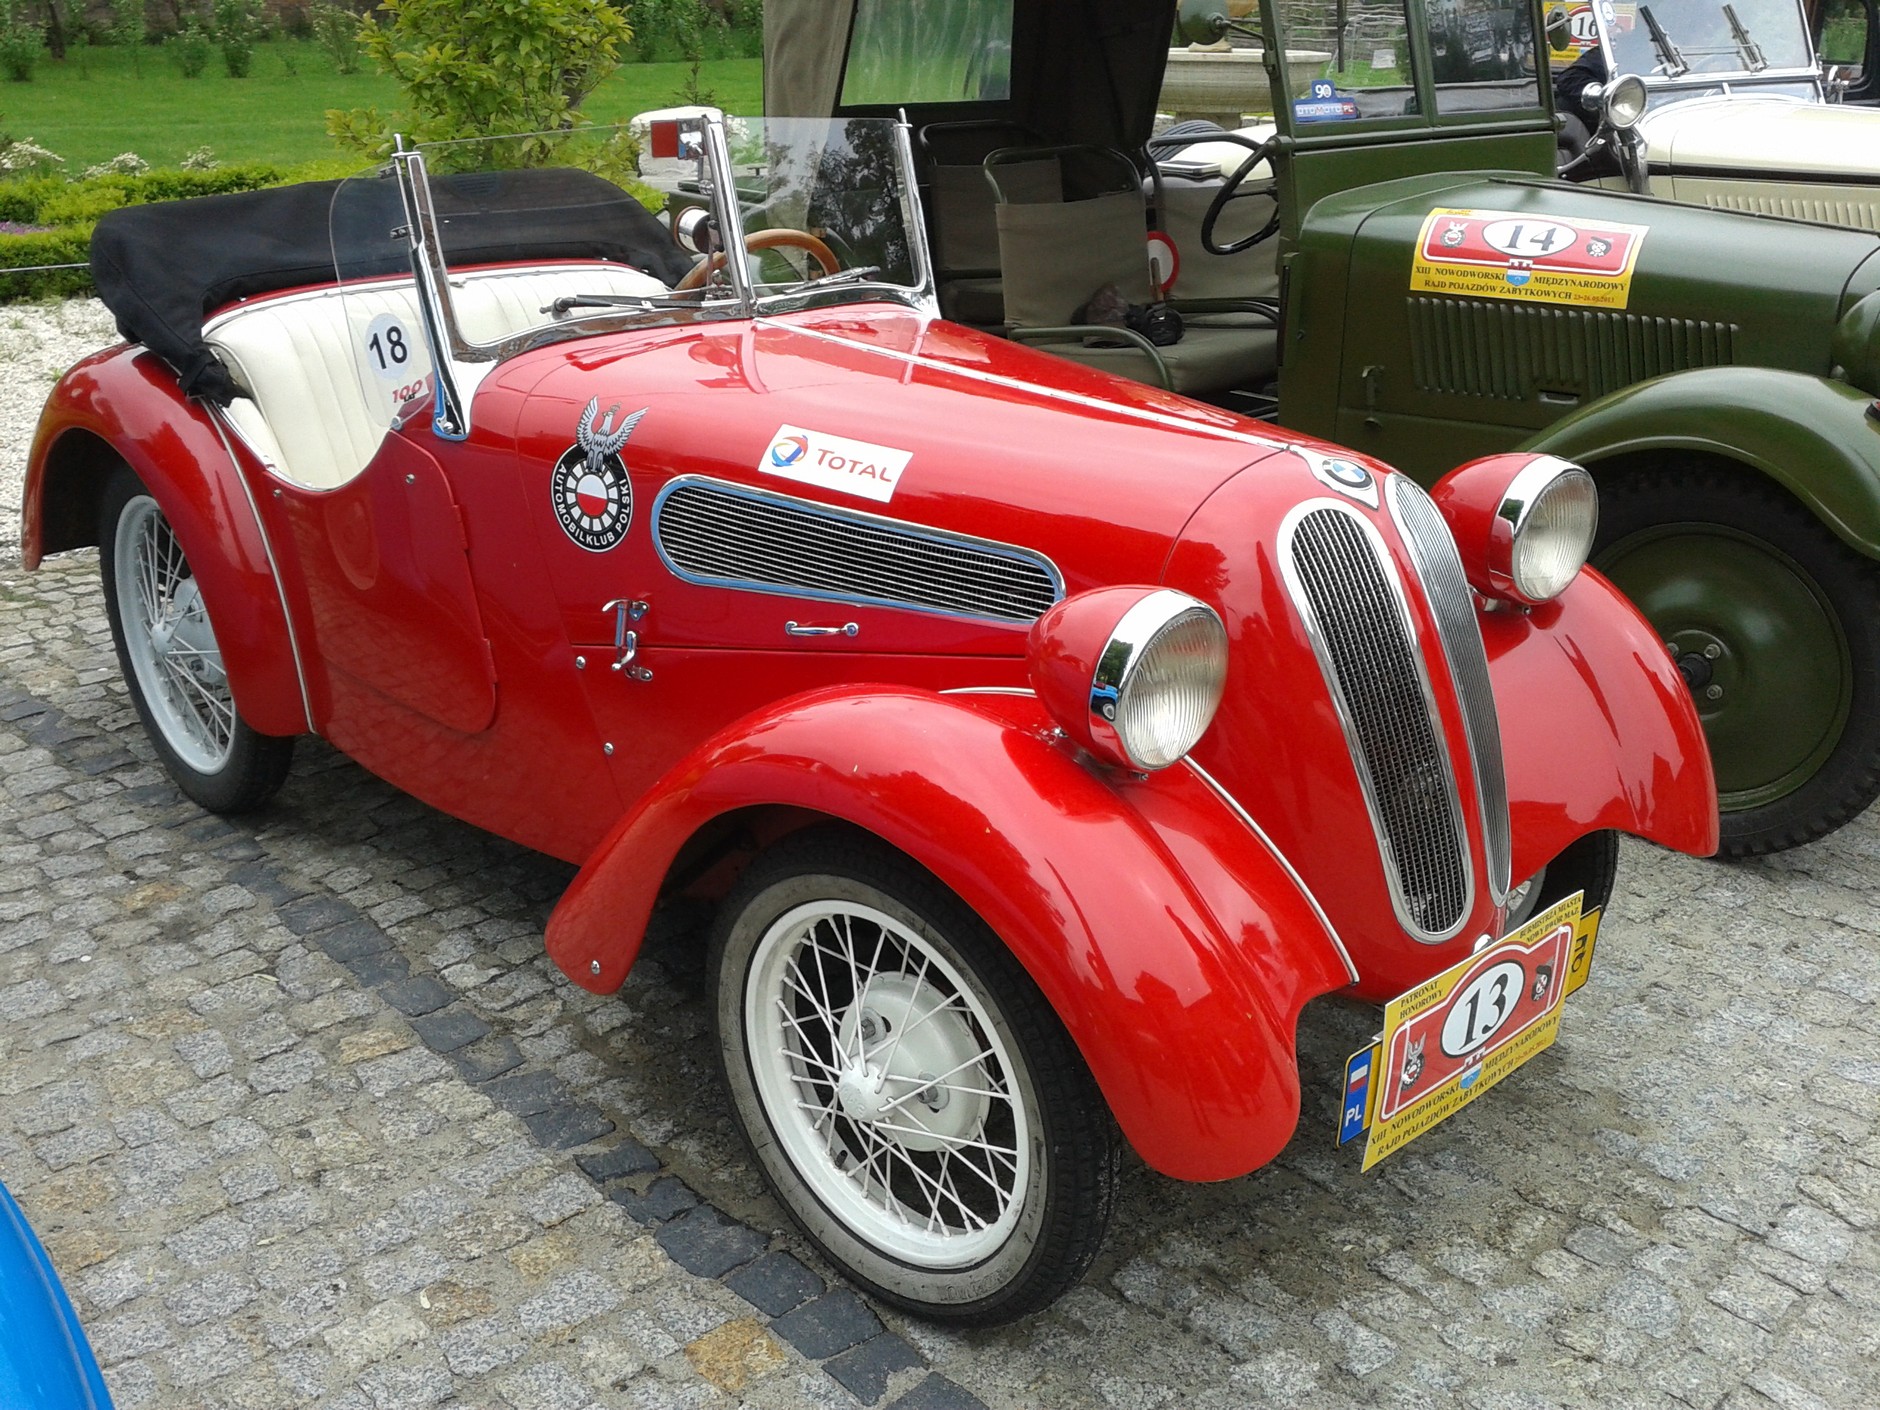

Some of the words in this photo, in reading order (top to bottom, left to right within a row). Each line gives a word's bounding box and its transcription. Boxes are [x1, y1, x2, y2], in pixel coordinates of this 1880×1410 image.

[1577, 16, 1599, 37] 16
[1315, 84, 1332, 98] 90
[1502, 225, 1557, 251] 14
[1415, 266, 1431, 275] XIII
[1434, 268, 1505, 281] NOWODWORSKI
[1533, 276, 1627, 291] MIĘDZYNARODOWY
[1424, 280, 1447, 289] RAJD
[1448, 281, 1498, 293] POJAZDÓW
[1499, 286, 1572, 300] ZABYTKOWYCH
[369, 326, 408, 370] 18
[392, 379, 423, 403] 100
[817, 448, 892, 483] TOTAL
[555, 463, 616, 546] AUTOMOBILKLUB
[615, 479, 631, 534] POLSKI
[1399, 989, 1443, 1019] HONOROWY
[1400, 981, 1439, 1008] PATRONAT
[1459, 973, 1509, 1051] 13
[1345, 1104, 1362, 1127] PL
[1377, 1135, 1401, 1157] RAJD
[1402, 1104, 1450, 1141] POJAZDÓW
[1452, 1058, 1514, 1107] ZABYTKOWYCH
[1390, 1081, 1460, 1134] NOWODWORSKI
